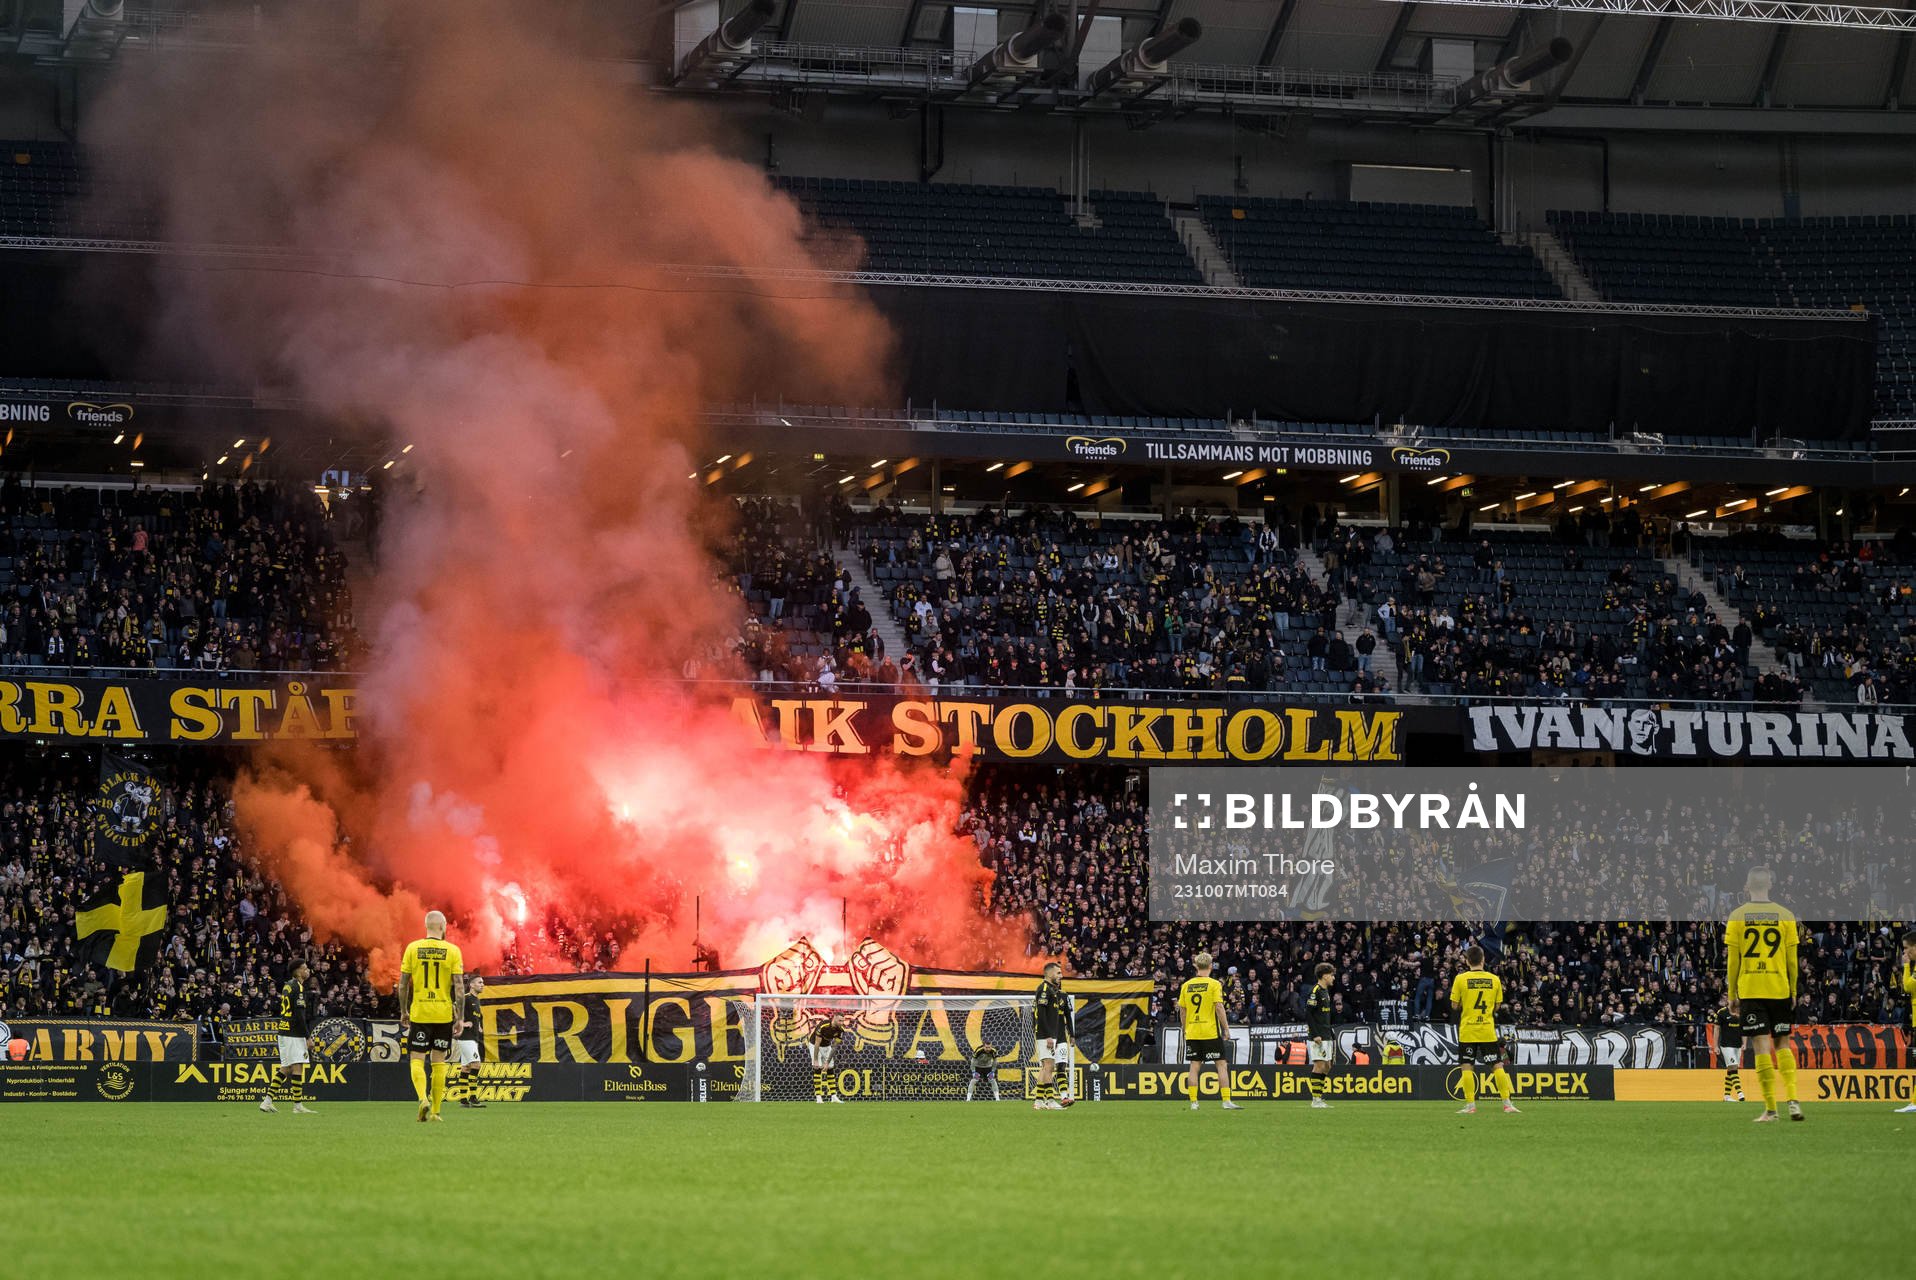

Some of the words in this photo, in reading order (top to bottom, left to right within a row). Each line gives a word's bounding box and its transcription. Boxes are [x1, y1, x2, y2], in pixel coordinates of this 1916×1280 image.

[0, 404, 50, 421] BNING
[77, 409, 123, 422] friends
[1075, 442, 1117, 455] friends
[1145, 443, 1254, 461] TILLSAMMANS
[1259, 447, 1289, 463] MOT
[1295, 448, 1372, 466] MOBBNING
[1400, 453, 1441, 466] friends
[727, 697, 870, 754] AIK
[892, 701, 1402, 762] STOCKHOLM
[1468, 705, 1628, 751] IVAN
[1661, 708, 1915, 759] TURINA
[100, 772, 140, 794] BLACK
[1743, 927, 1782, 958] 29
[421, 961, 440, 989] 11
[1191, 993, 1203, 1014] 9
[1473, 990, 1488, 1015] 4
[228, 1023, 241, 1033] VI
[264, 1021, 279, 1031] FR
[1250, 1025, 1310, 1034] YOUNGSTERS
[28, 1028, 178, 1062] ARMY
[227, 1033, 279, 1043] STOCKHO
[235, 1047, 249, 1057] VI
[107, 1071, 123, 1080] L&S
[890, 1072, 901, 1081] Vi
[1231, 1070, 1268, 1091] ICA
[1479, 1072, 1589, 1094] KAPPEX
[219, 1087, 249, 1095] Sjunger
[604, 1079, 667, 1091] ElléniusBuss
[1248, 1089, 1268, 1097] nära
